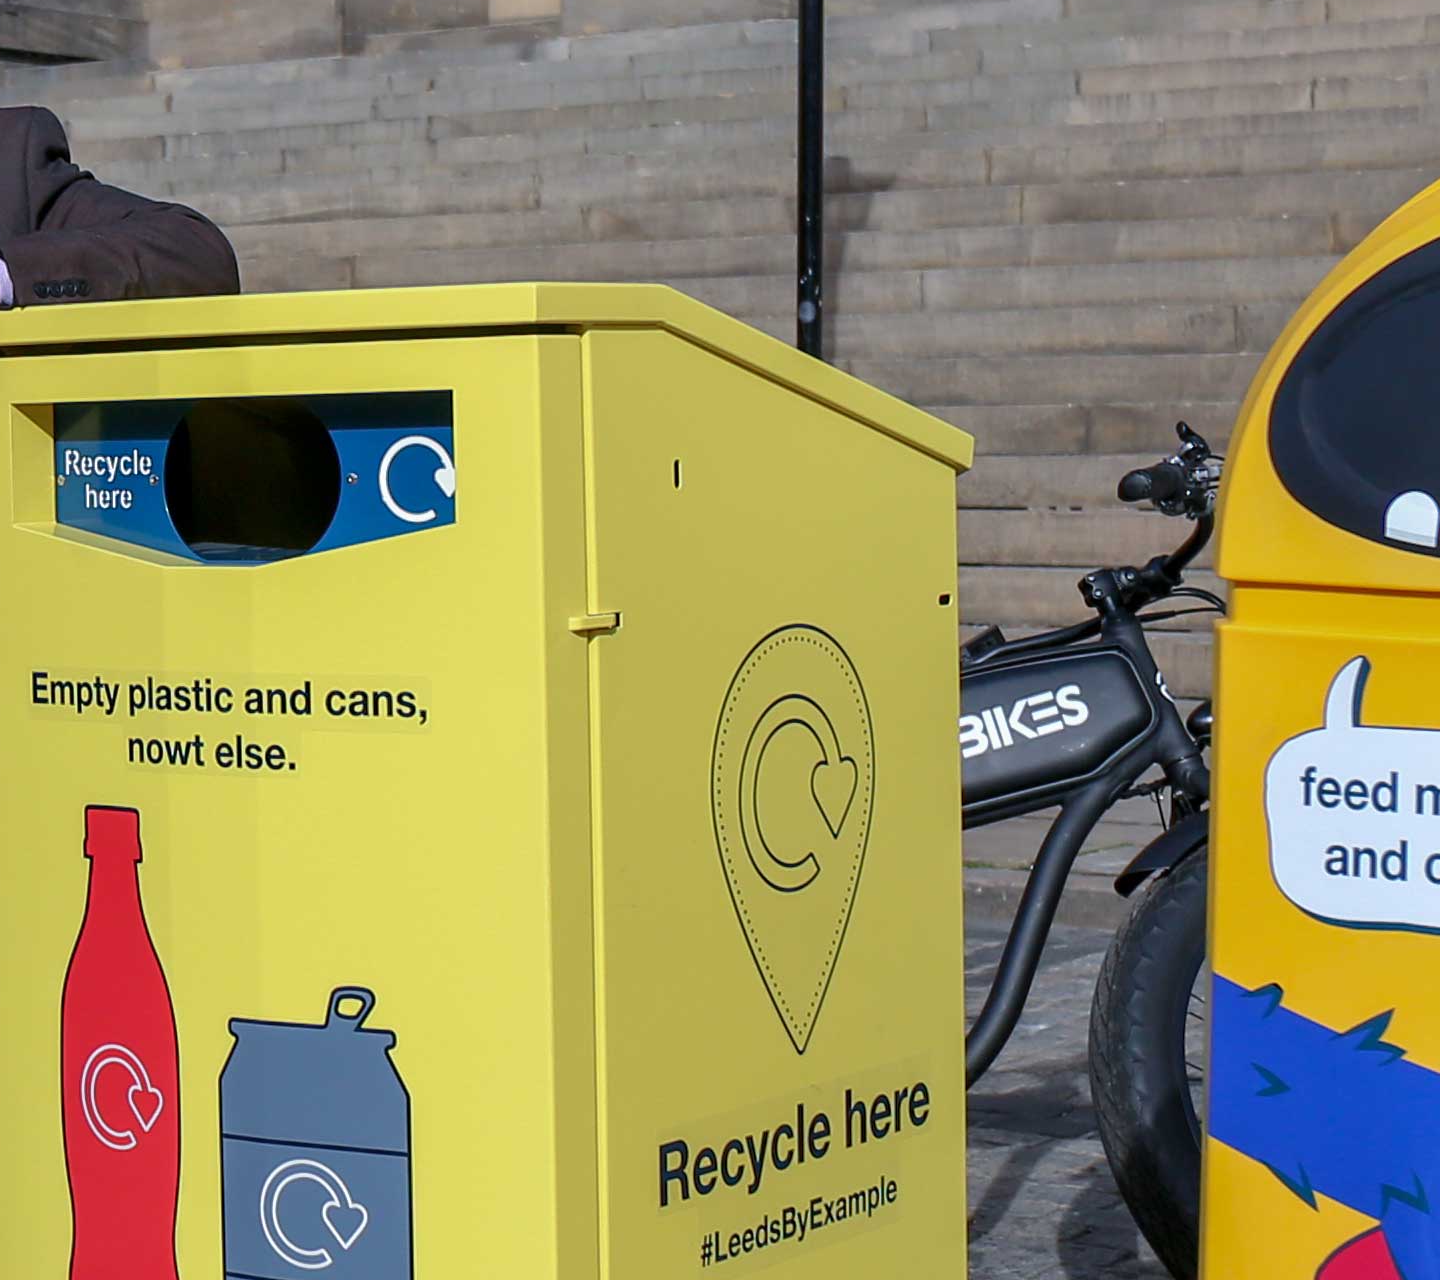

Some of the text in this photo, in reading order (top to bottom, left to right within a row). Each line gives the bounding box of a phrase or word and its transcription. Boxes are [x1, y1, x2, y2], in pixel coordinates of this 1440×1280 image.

[65, 449, 153, 482] Recycle
[85, 484, 133, 510] here
[32, 672, 428, 725] Empty plastic and cans,
[959, 684, 1090, 758] BIKES
[128, 734, 297, 771] nowt else.
[1300, 765, 1399, 814] feed
[1324, 840, 1408, 882] and
[659, 1080, 930, 1208] Recycle here
[700, 1176, 897, 1267] #LeedsByExample
